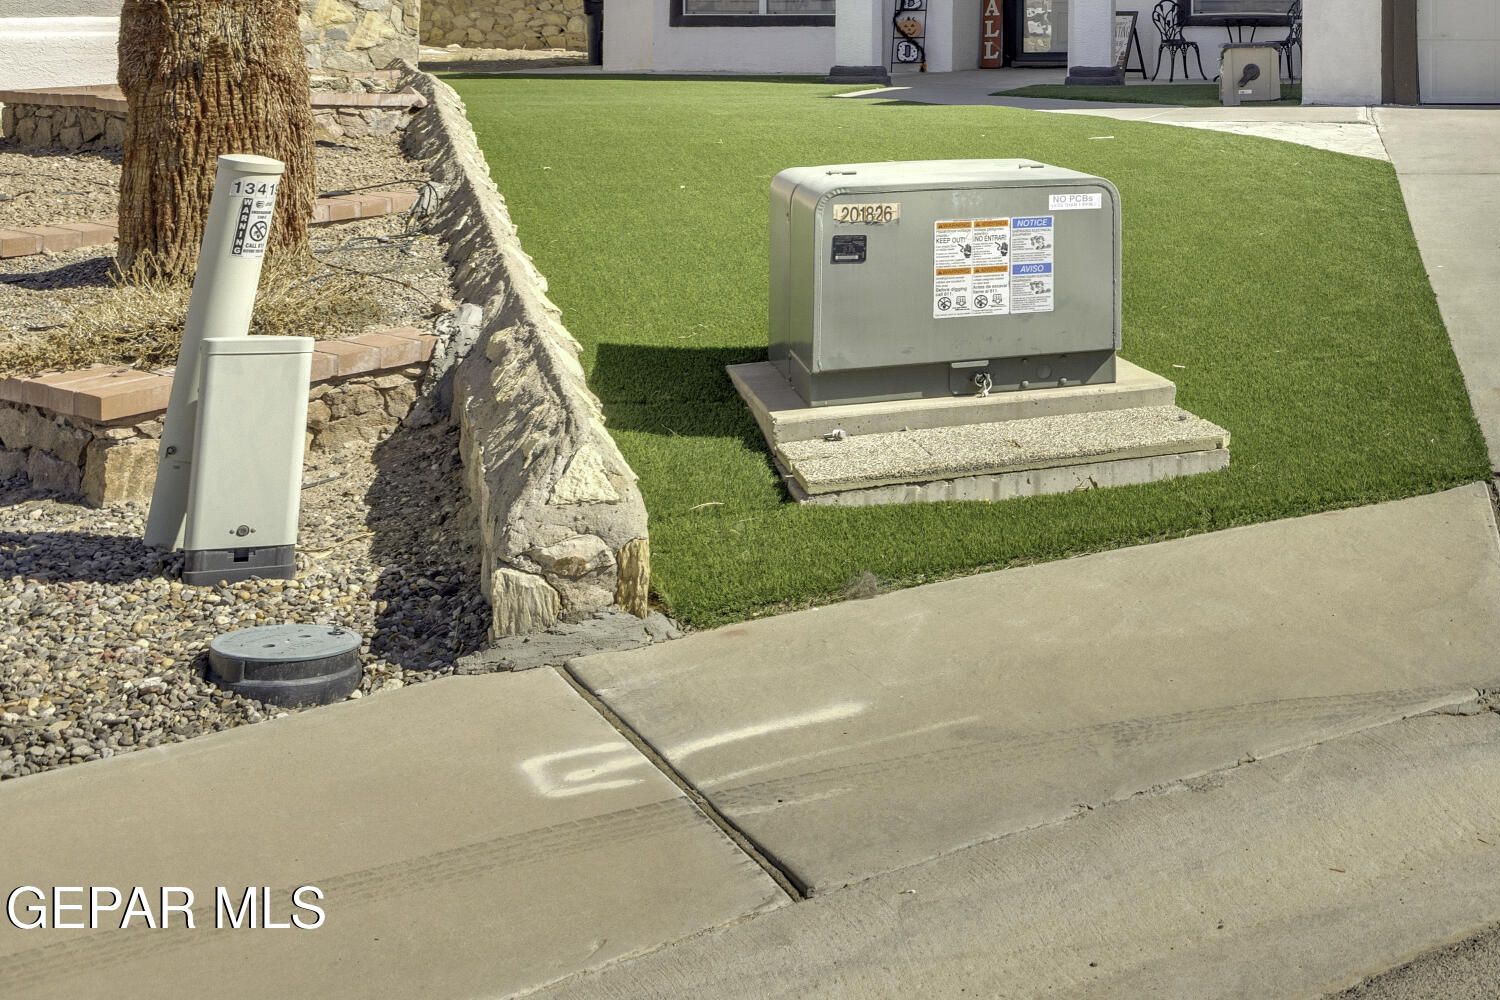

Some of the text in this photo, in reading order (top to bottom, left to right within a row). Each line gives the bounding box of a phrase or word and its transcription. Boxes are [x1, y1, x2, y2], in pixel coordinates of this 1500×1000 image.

[1052, 194, 1094, 204] NO PCBs
[840, 205, 893, 223] 201826
[233, 198, 252, 254] WARNING
[1016, 218, 1048, 227] NOTICE
[1020, 264, 1044, 273] AVISO
